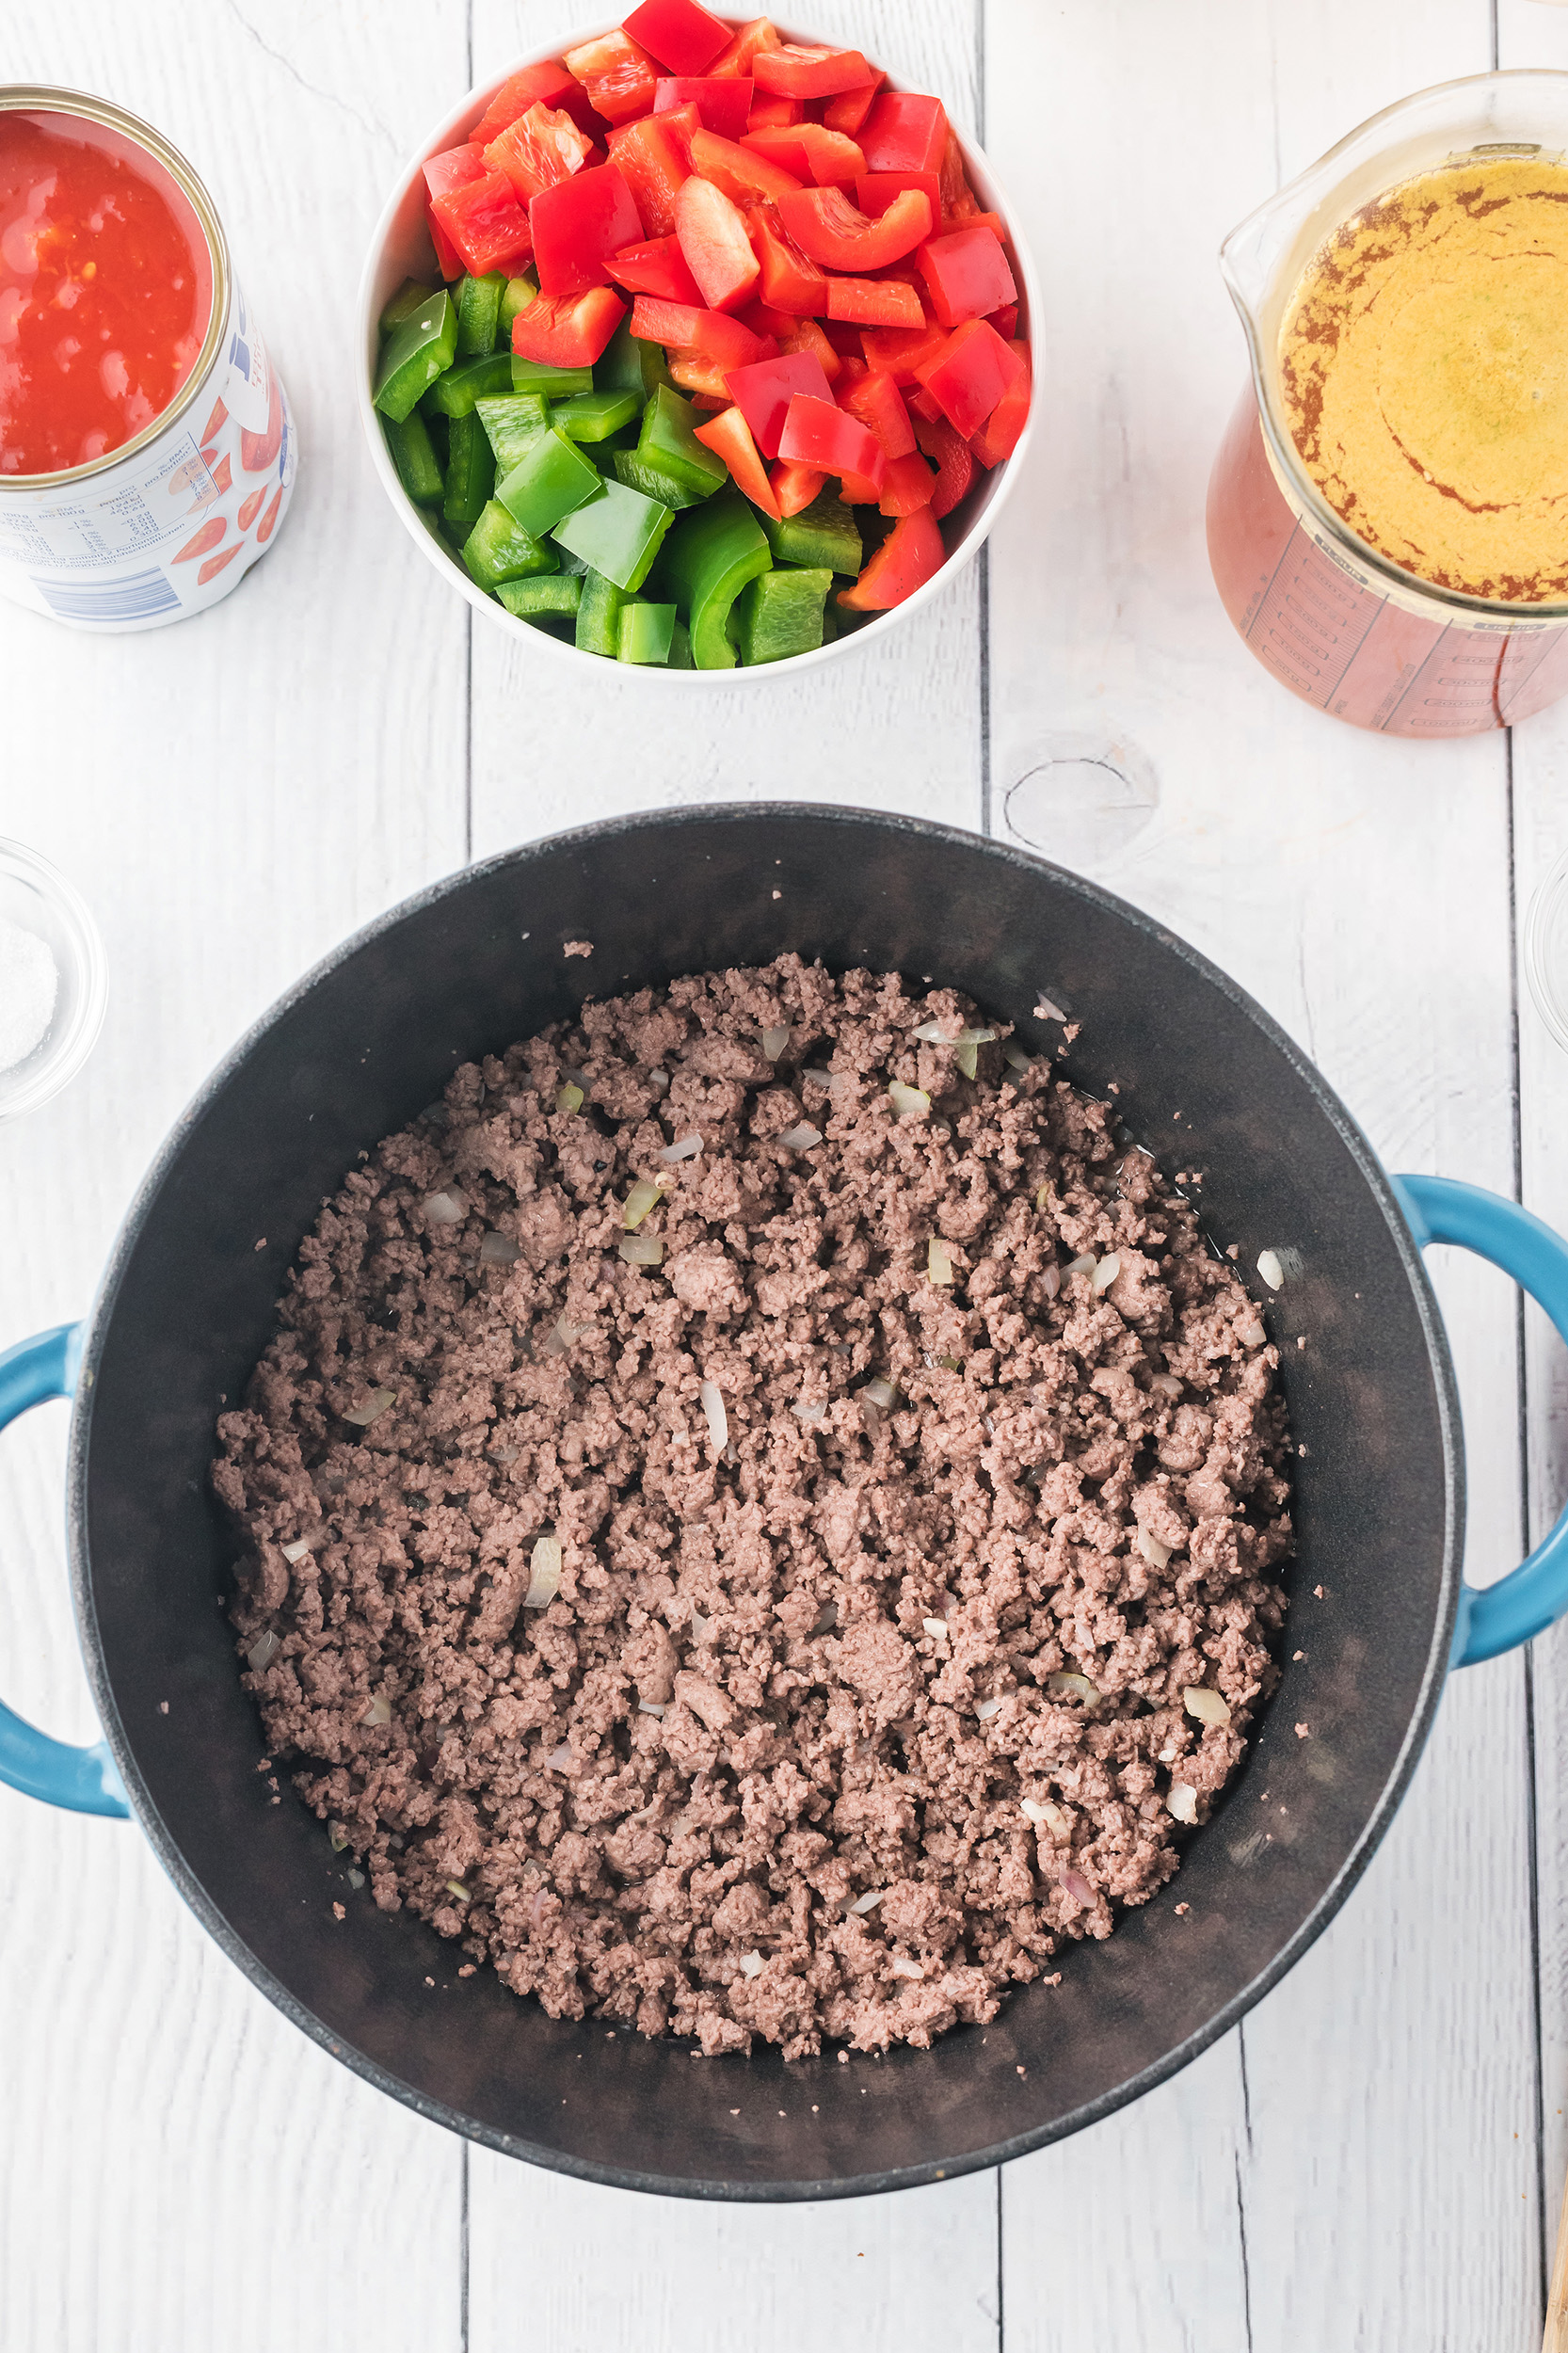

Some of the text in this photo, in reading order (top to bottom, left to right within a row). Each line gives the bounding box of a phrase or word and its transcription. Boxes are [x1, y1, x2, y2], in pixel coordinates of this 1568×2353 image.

[120, 486, 135, 495] pro
[144, 475, 159, 488] pro
[116, 533, 161, 552] Portionen
[1321, 542, 1363, 581] FLOUR
[1296, 606, 1318, 627] 200
[1289, 625, 1309, 645] 150
[1280, 641, 1301, 660] 100
[1275, 659, 1289, 673] 50
